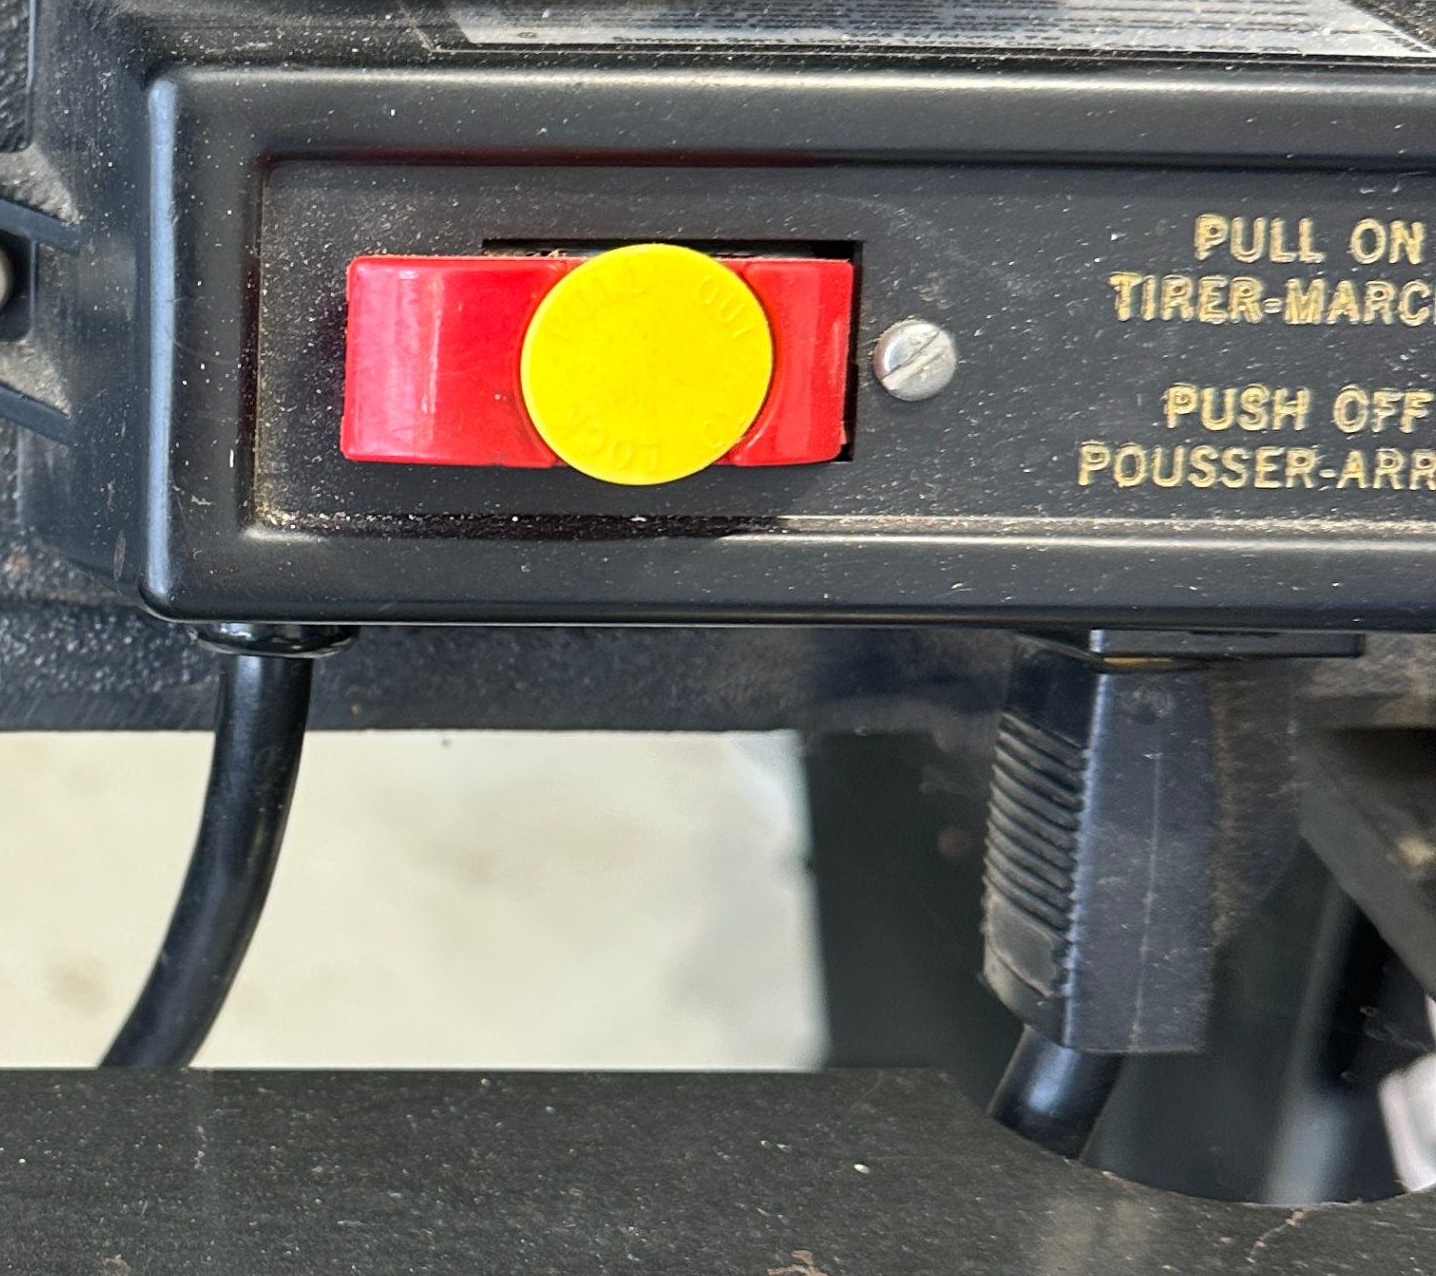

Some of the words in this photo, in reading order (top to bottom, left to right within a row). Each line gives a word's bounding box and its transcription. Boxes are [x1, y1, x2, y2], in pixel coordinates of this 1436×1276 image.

[1193, 213, 1326, 264] PULL
[1351, 218, 1425, 265] ON
[695, 275, 755, 340] OUT
[1109, 272, 1436, 327] TIRER-MARC
[1163, 382, 1310, 431] PUSH
[1332, 384, 1436, 434] OFF
